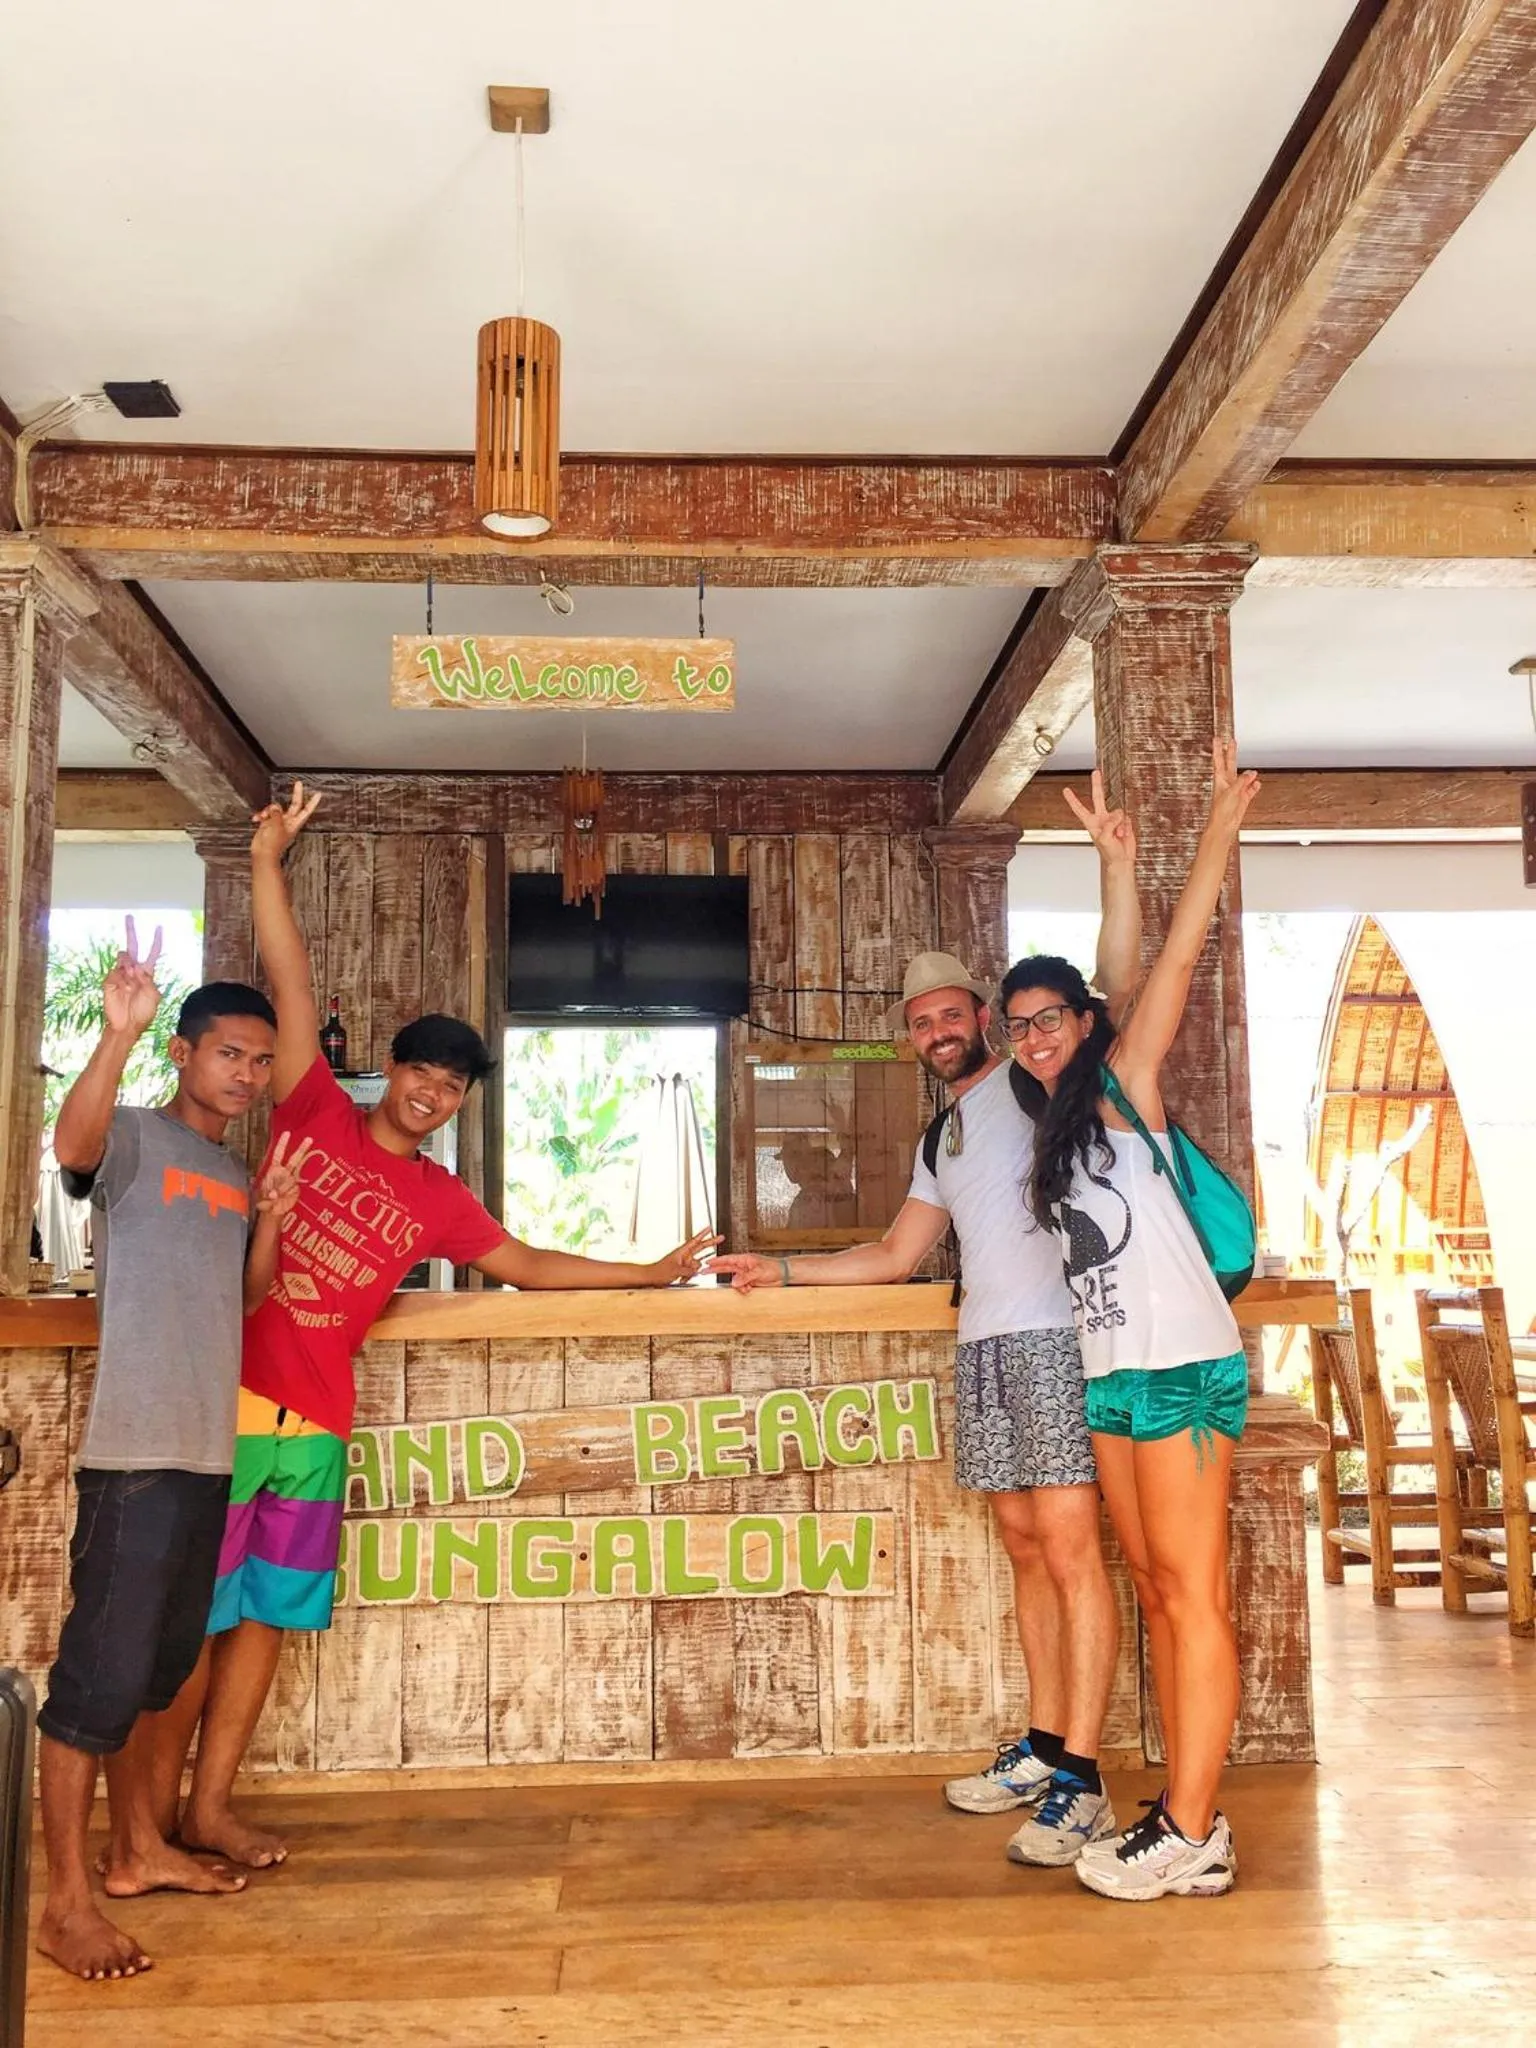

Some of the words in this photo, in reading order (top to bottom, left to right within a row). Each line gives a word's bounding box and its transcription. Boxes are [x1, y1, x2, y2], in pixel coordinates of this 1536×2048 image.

[673, 656, 732, 699] to
[298, 1148, 424, 1258] CELCIUS
[316, 1208, 334, 1225] IS
[328, 1218, 368, 1249] BUILT
[291, 1220, 359, 1280] RAISING
[353, 1264, 378, 1289] UP
[631, 1379, 936, 1485] BEACH
